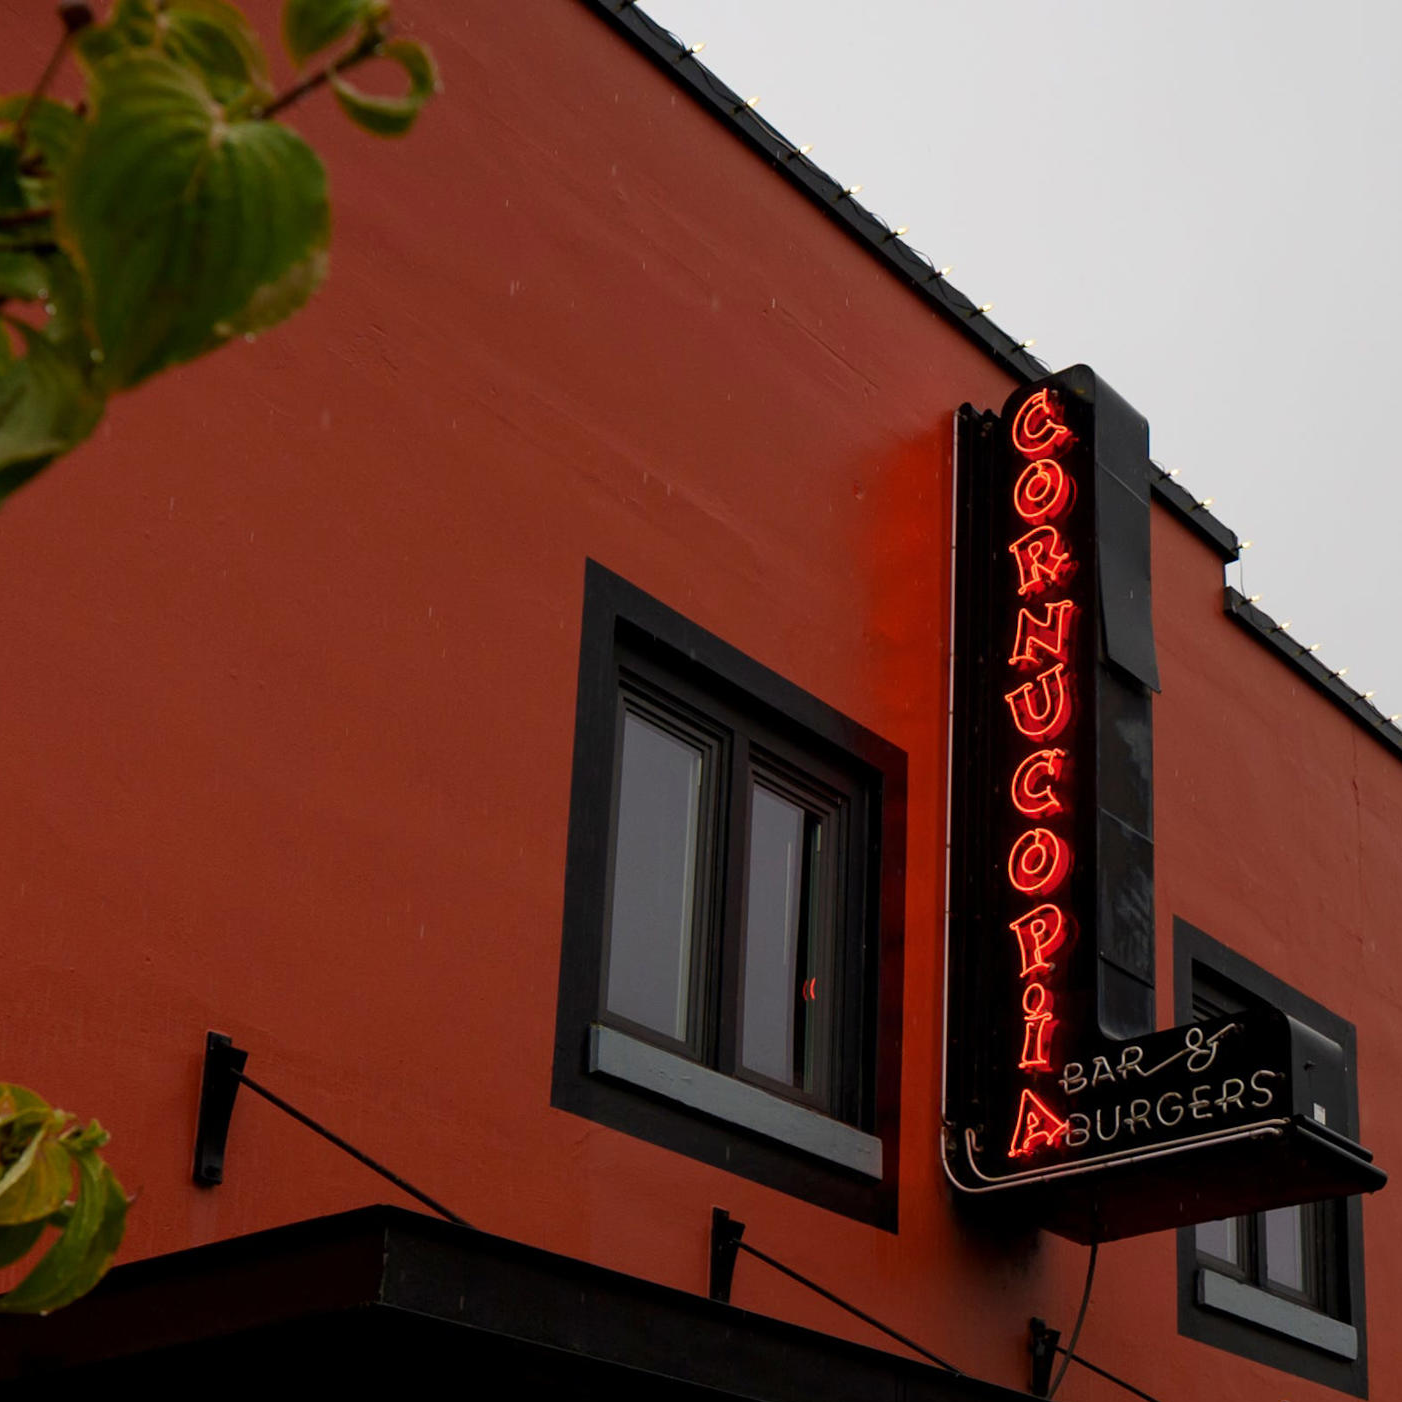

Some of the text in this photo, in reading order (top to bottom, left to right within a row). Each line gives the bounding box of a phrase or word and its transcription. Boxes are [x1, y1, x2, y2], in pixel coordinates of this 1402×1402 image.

[1058, 1026, 1240, 1094] BAR &
[1065, 1069, 1281, 1146] BURGERS
